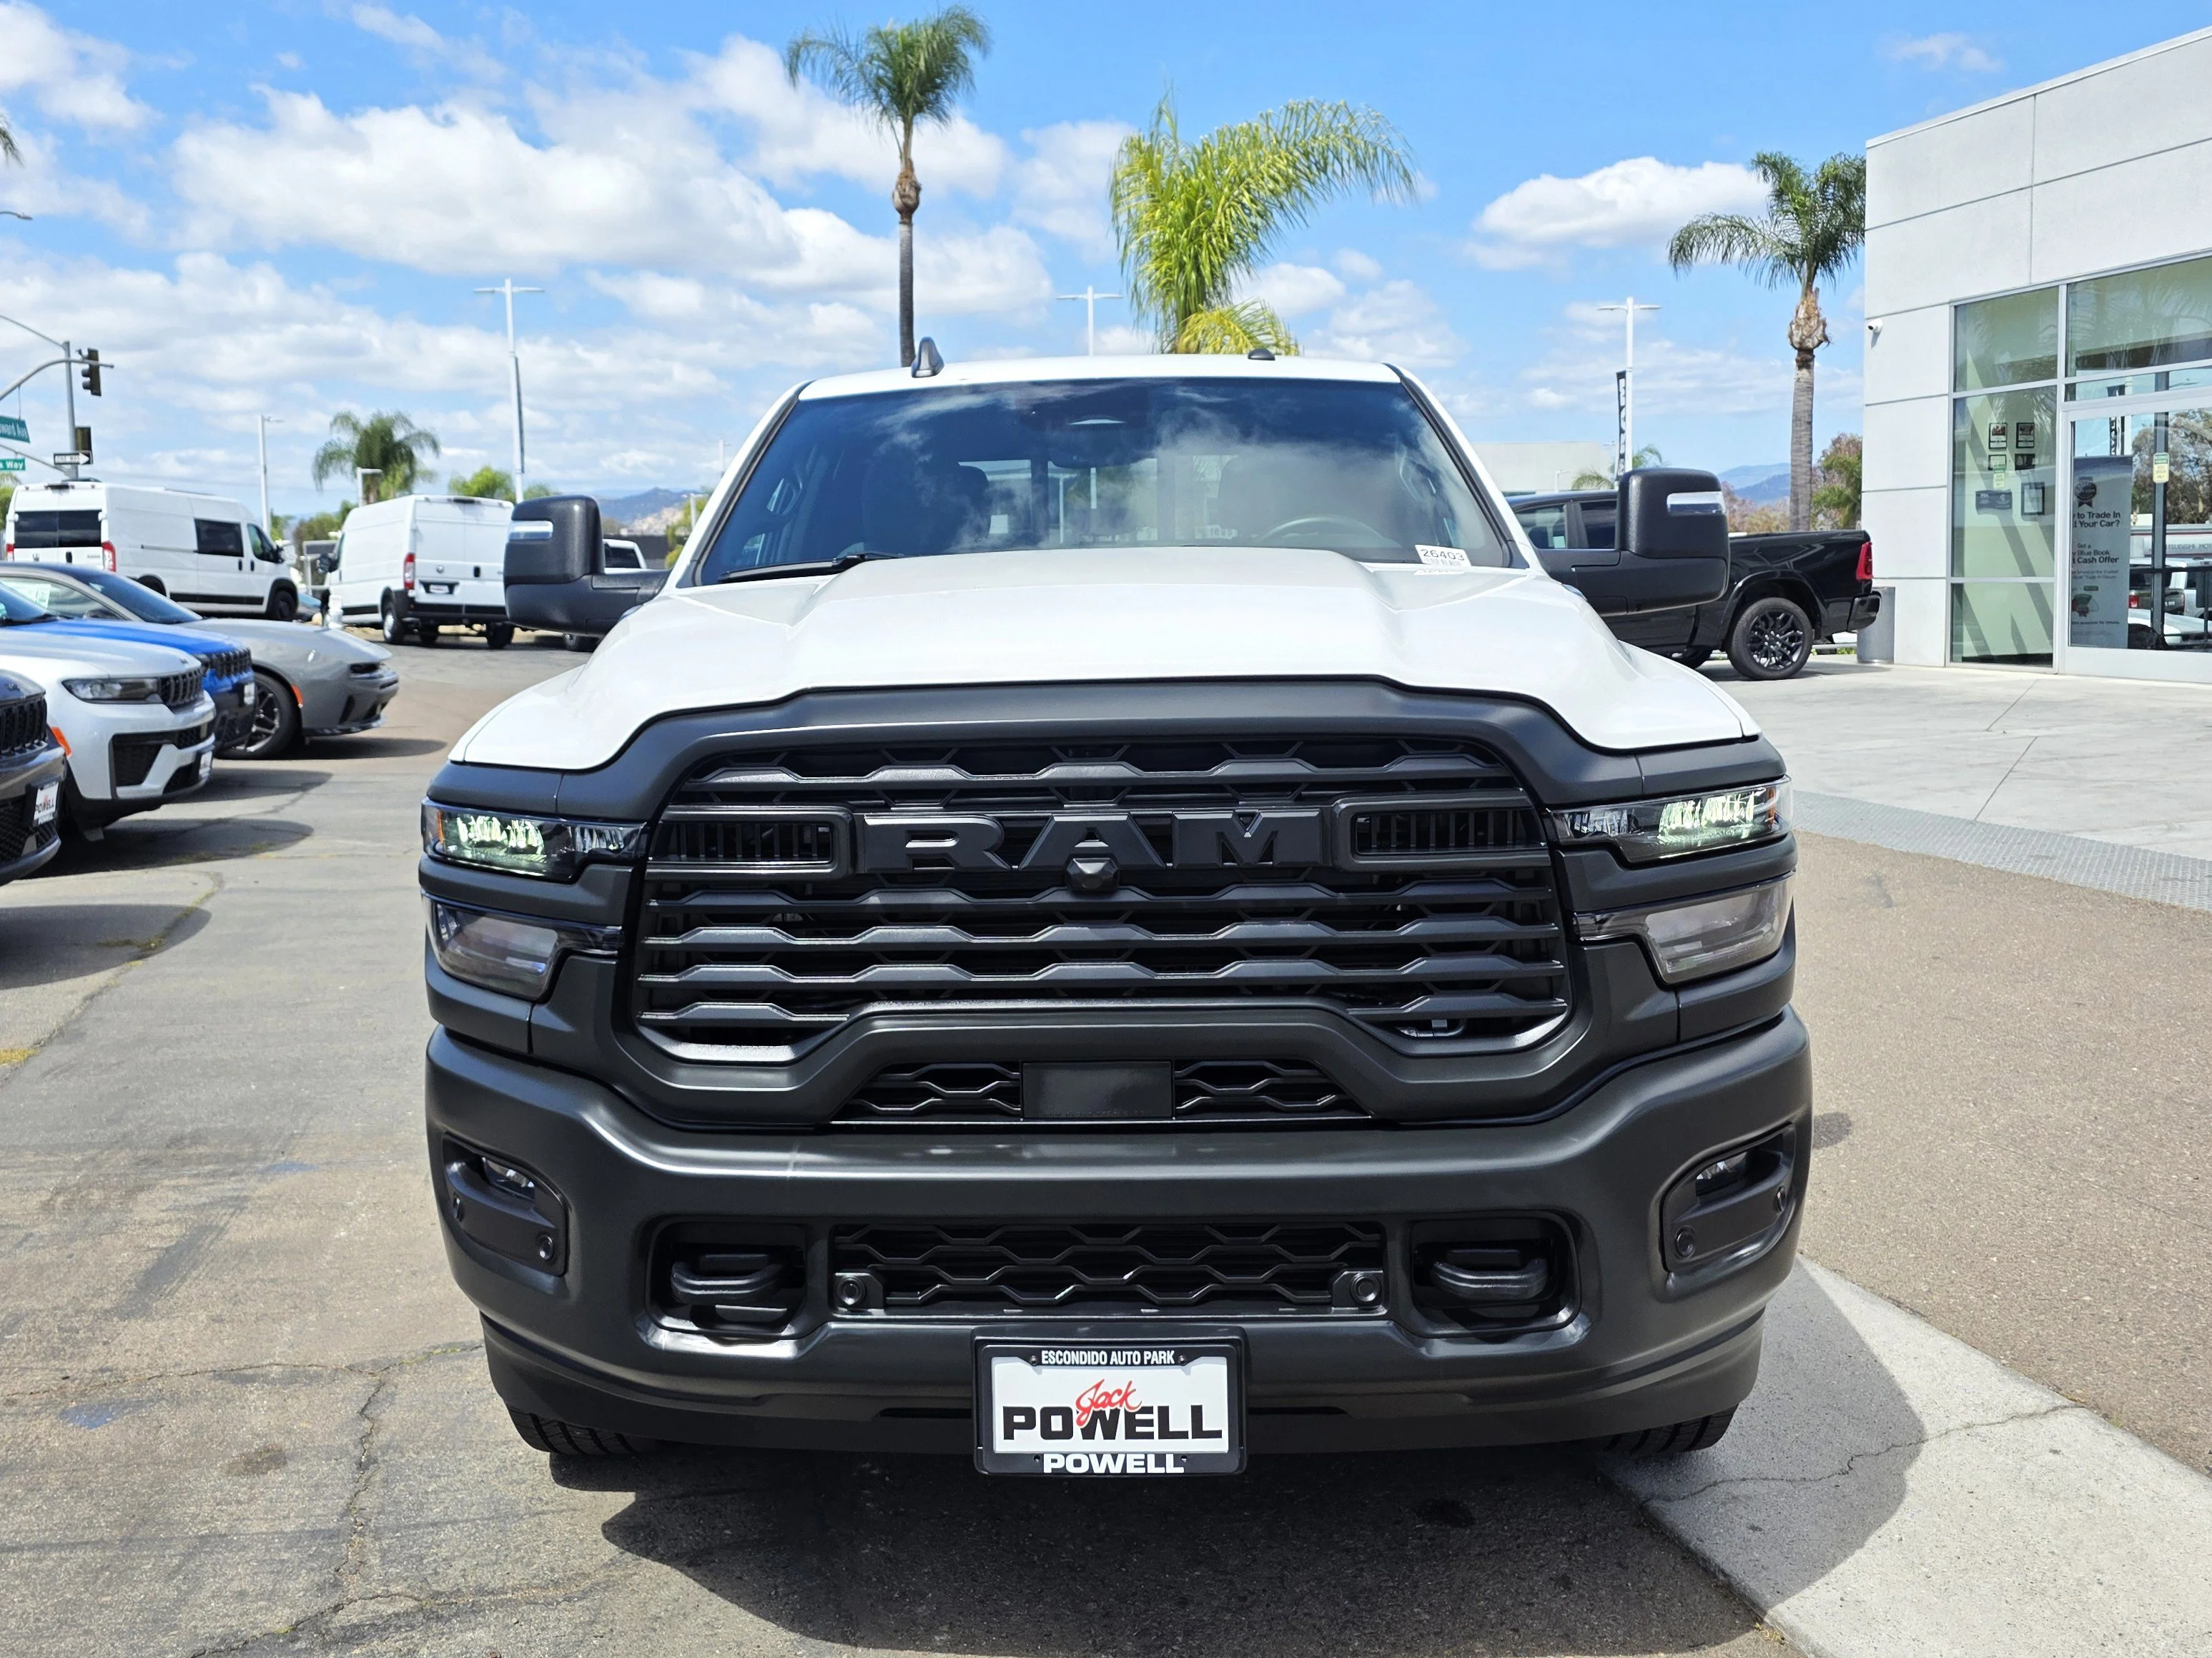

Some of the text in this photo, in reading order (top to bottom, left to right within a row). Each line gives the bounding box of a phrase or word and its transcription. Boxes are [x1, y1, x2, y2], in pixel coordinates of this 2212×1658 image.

[6, 460, 24, 470] Way
[2087, 510, 2111, 519] Trade
[2099, 519, 2120, 528] Car?
[1421, 548, 1465, 561] 26403
[864, 809, 1321, 872] RAM
[1041, 1350, 1175, 1365] ESCONDIDO AUTO PARK
[1075, 1378, 1143, 1428] Jack
[1002, 1404, 1223, 1440] POWELL
[1043, 1453, 1185, 1474] POWELL
